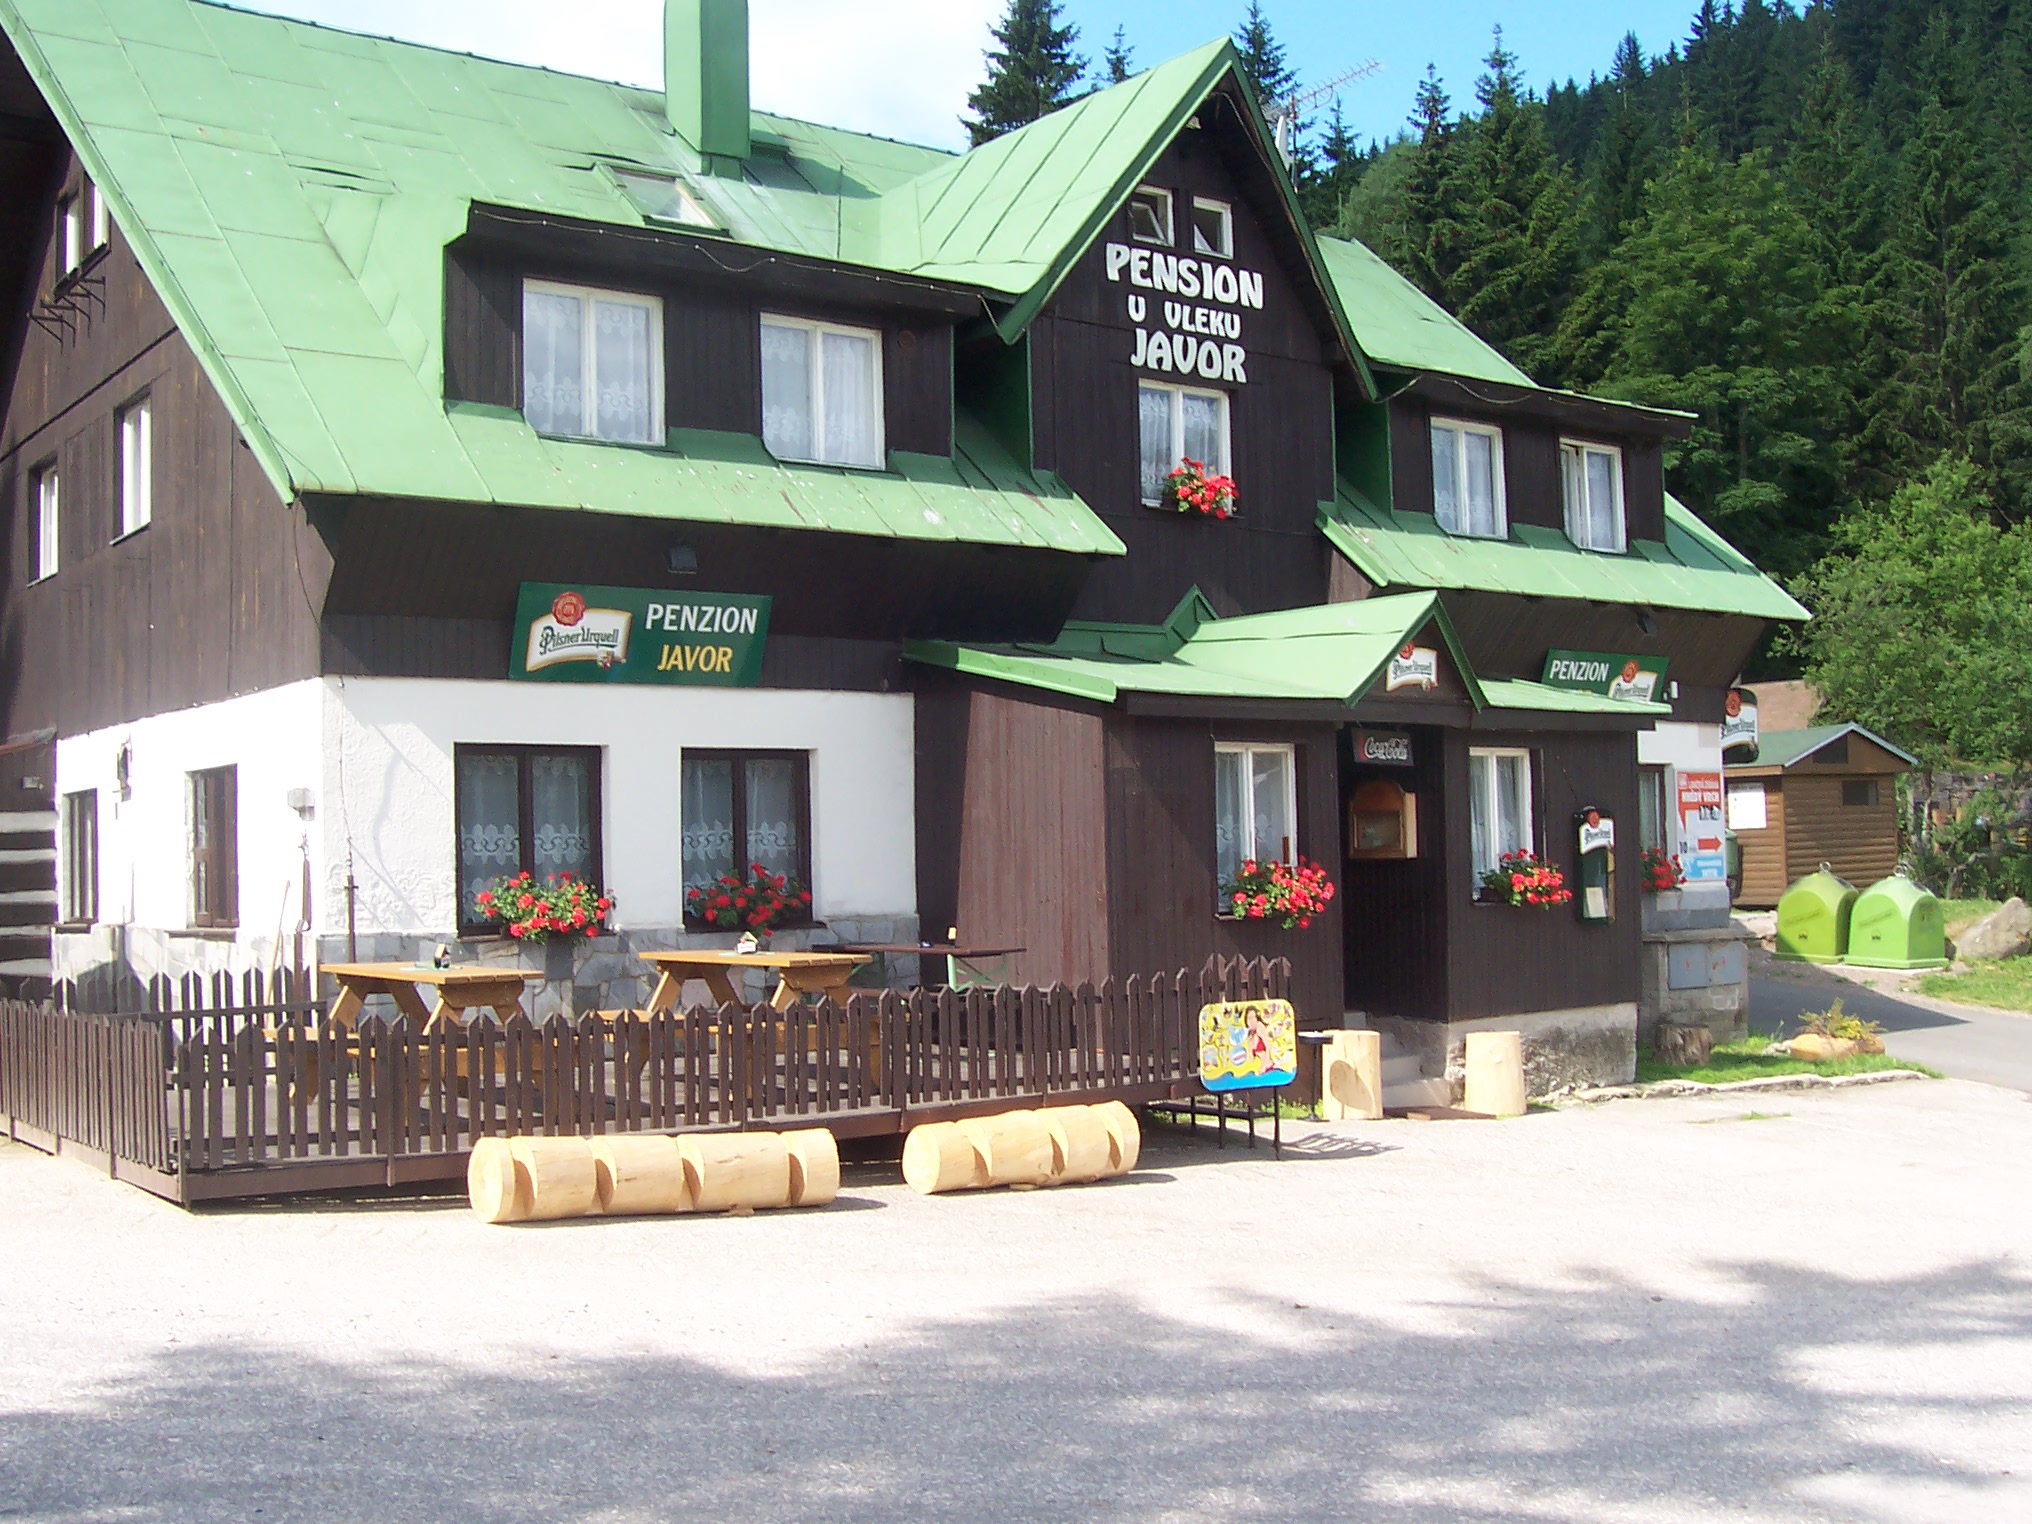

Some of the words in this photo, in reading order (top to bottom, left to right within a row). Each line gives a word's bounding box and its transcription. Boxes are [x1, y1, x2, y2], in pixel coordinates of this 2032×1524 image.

[1106, 242, 1264, 310] PENSION
[1127, 294, 1147, 323] U
[1164, 301, 1241, 340] VLEKU
[1130, 328, 1247, 384] JAVOR
[644, 602, 758, 634] PENZION
[539, 625, 580, 656] Pilsner
[581, 625, 620, 649] Urquell
[656, 644, 734, 673] JAVOR
[1549, 659, 1610, 682] PENZION
